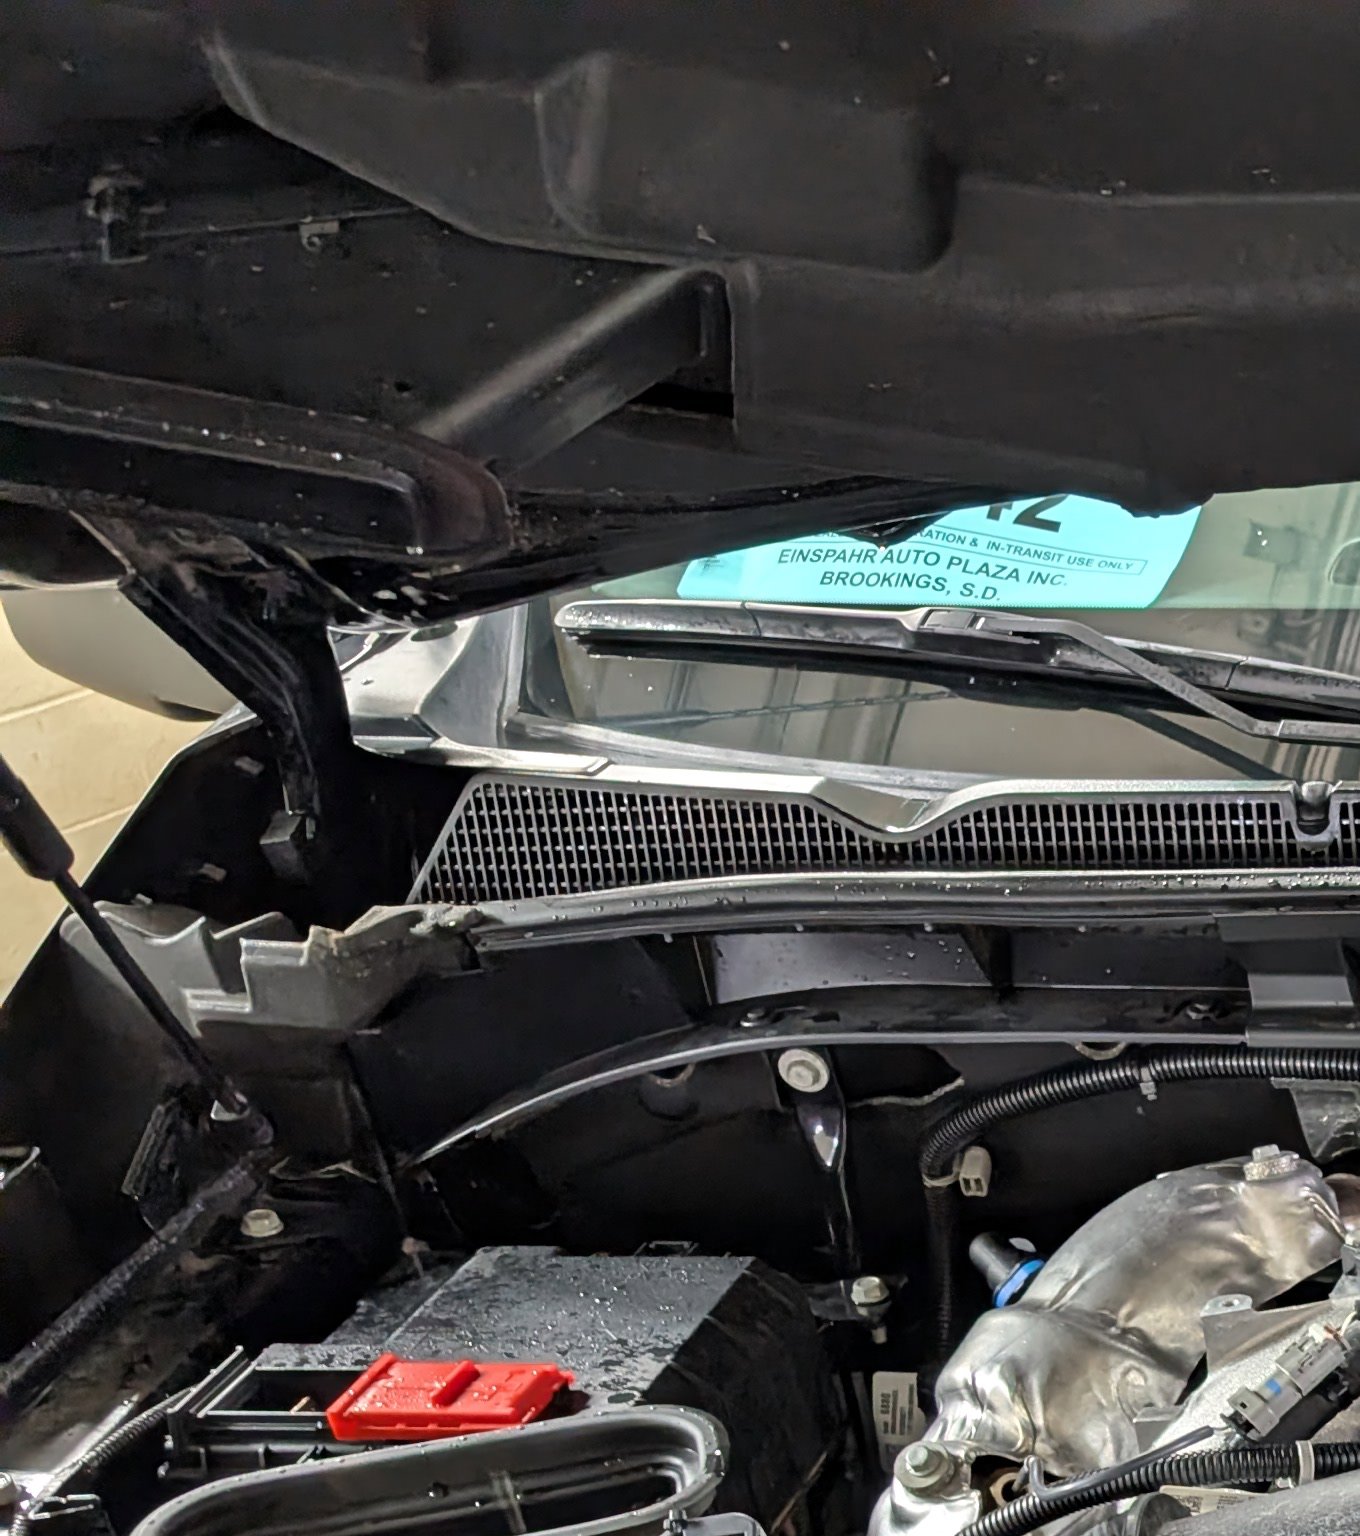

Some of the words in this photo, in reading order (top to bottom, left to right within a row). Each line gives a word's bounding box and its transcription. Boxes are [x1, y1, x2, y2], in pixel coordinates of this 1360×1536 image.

[777, 548, 878, 565] EINSPAHR
[879, 548, 941, 567] AUTO
[946, 555, 1021, 583] PLAZA
[1026, 570, 1069, 587] INC.
[969, 538, 979, 548] &
[986, 540, 1065, 564] IN-TRANSIT
[1067, 555, 1094, 568] USE
[1097, 560, 1134, 571] ONLY
[819, 570, 952, 596] BROOKINGS,
[959, 582, 1002, 602] S.D.
